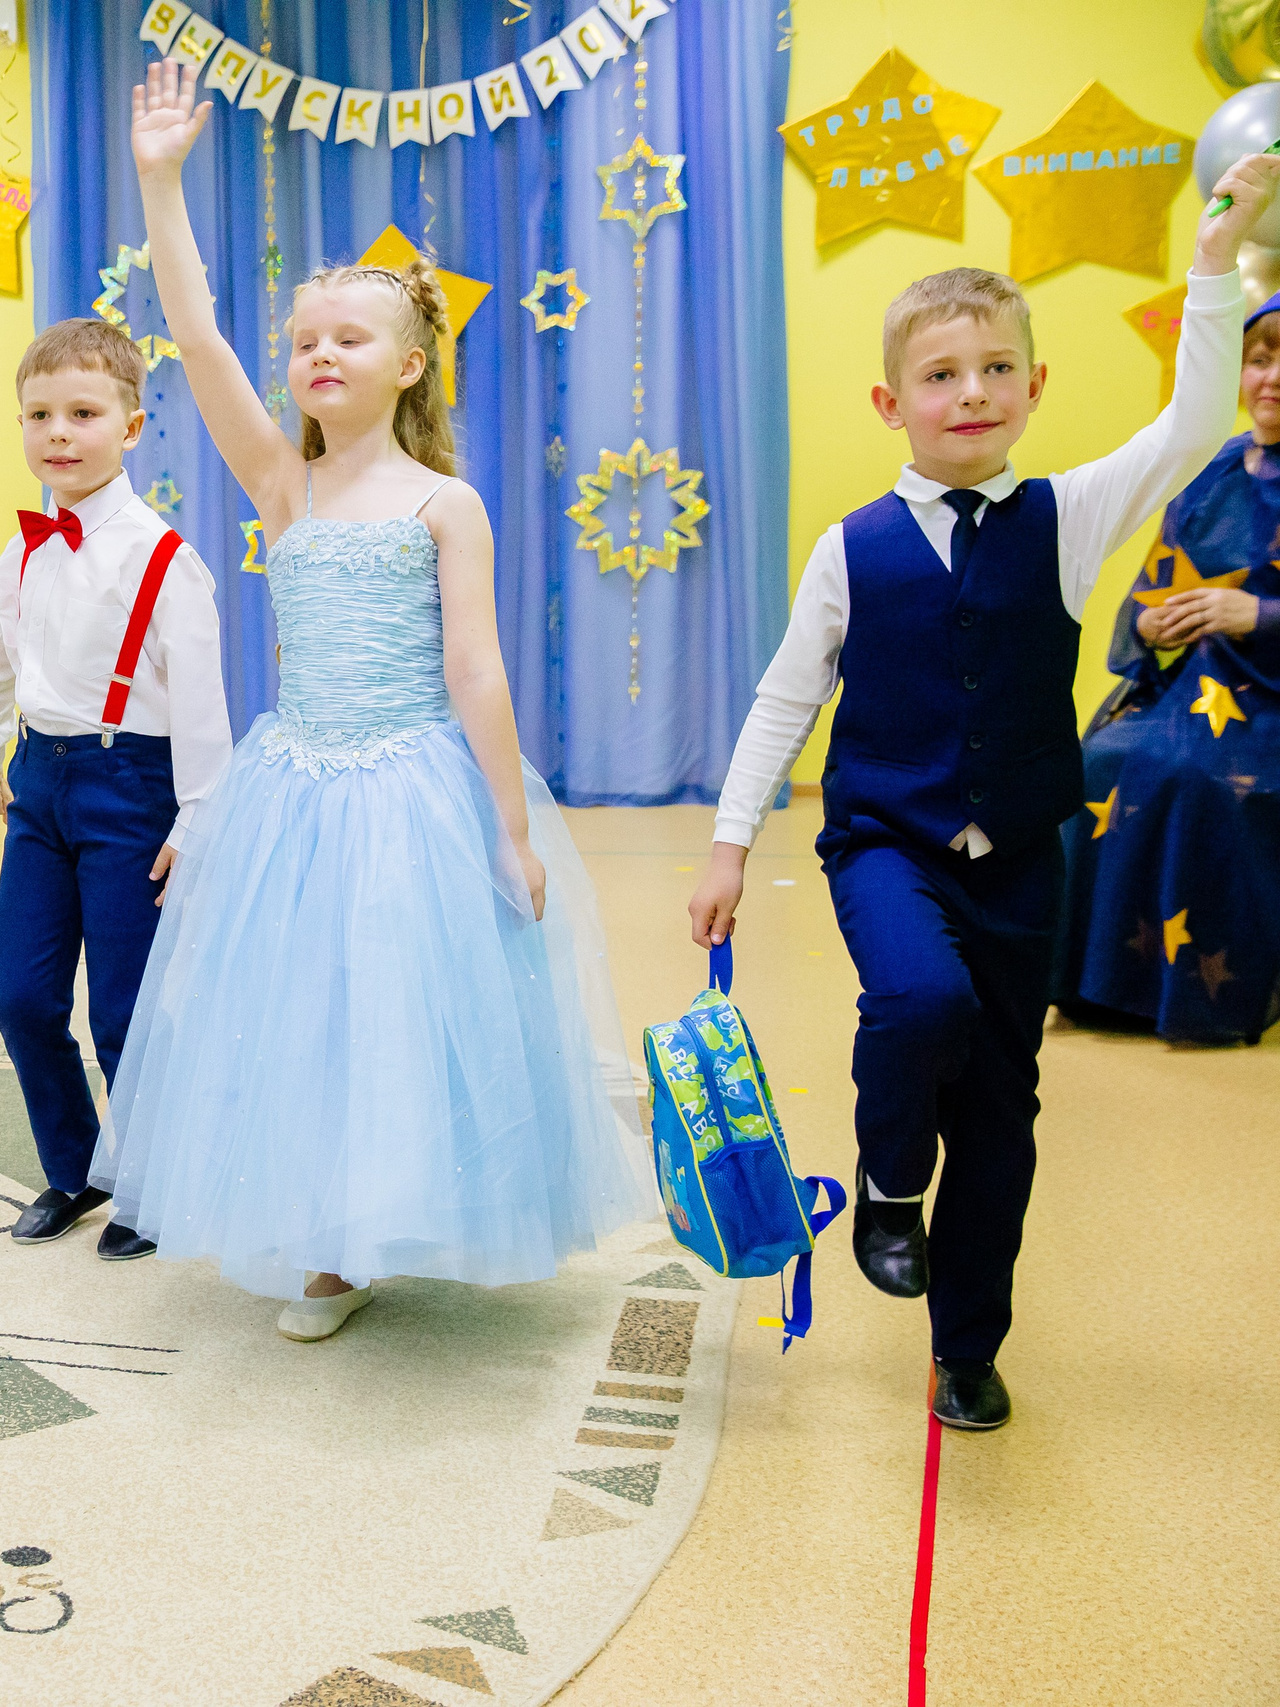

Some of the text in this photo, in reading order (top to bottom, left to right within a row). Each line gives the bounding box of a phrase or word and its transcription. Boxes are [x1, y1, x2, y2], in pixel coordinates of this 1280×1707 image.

[149, 3, 517, 133] ВЫПУСКНОЙ
[798, 94, 934, 147] ТРУДО
[828, 134, 971, 189] ЛЮБИЕ
[1003, 142, 1181, 177] ВНИМАНИЕ
[657, 1034, 696, 1079] ABC
[681, 1099, 717, 1151] ABC
